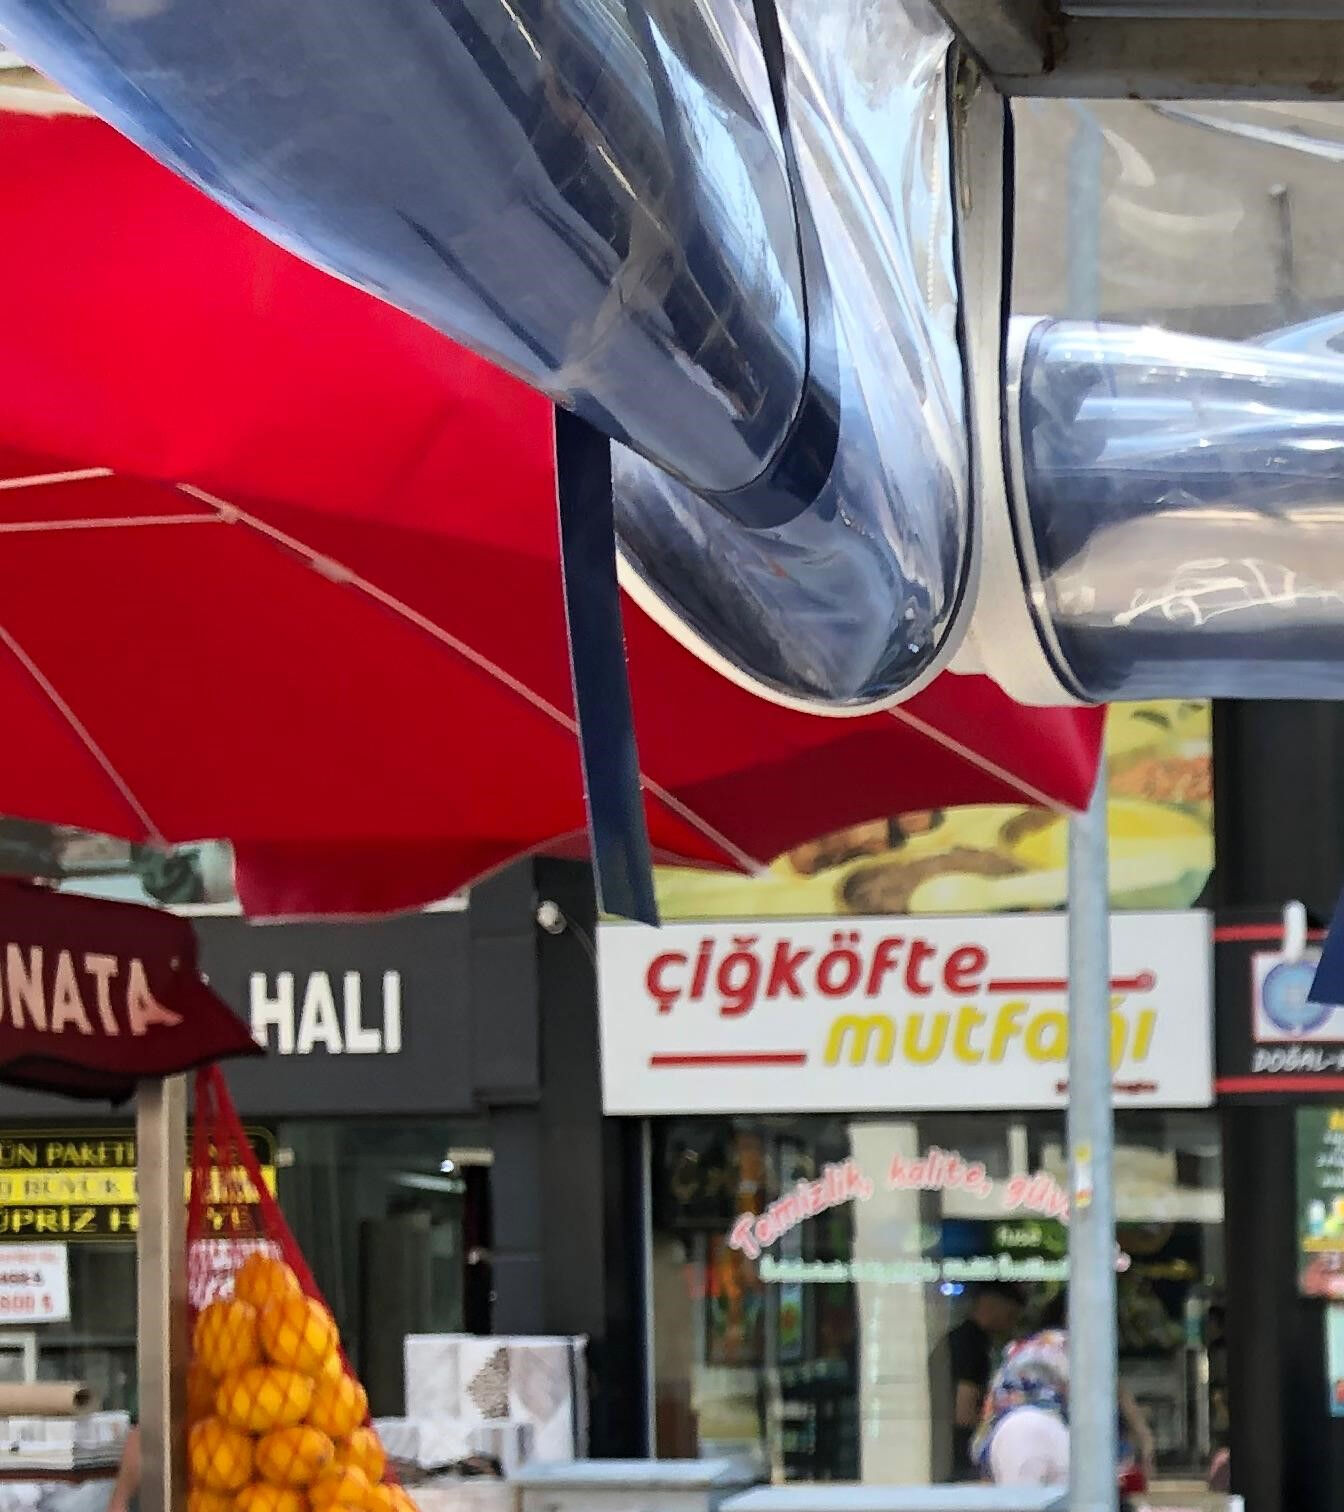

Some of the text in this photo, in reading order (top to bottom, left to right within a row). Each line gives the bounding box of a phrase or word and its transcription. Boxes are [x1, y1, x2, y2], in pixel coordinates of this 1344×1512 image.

[0, 941, 184, 1037] NATA
[248, 970, 402, 1055] HALI
[645, 931, 989, 1019] çiğköfte
